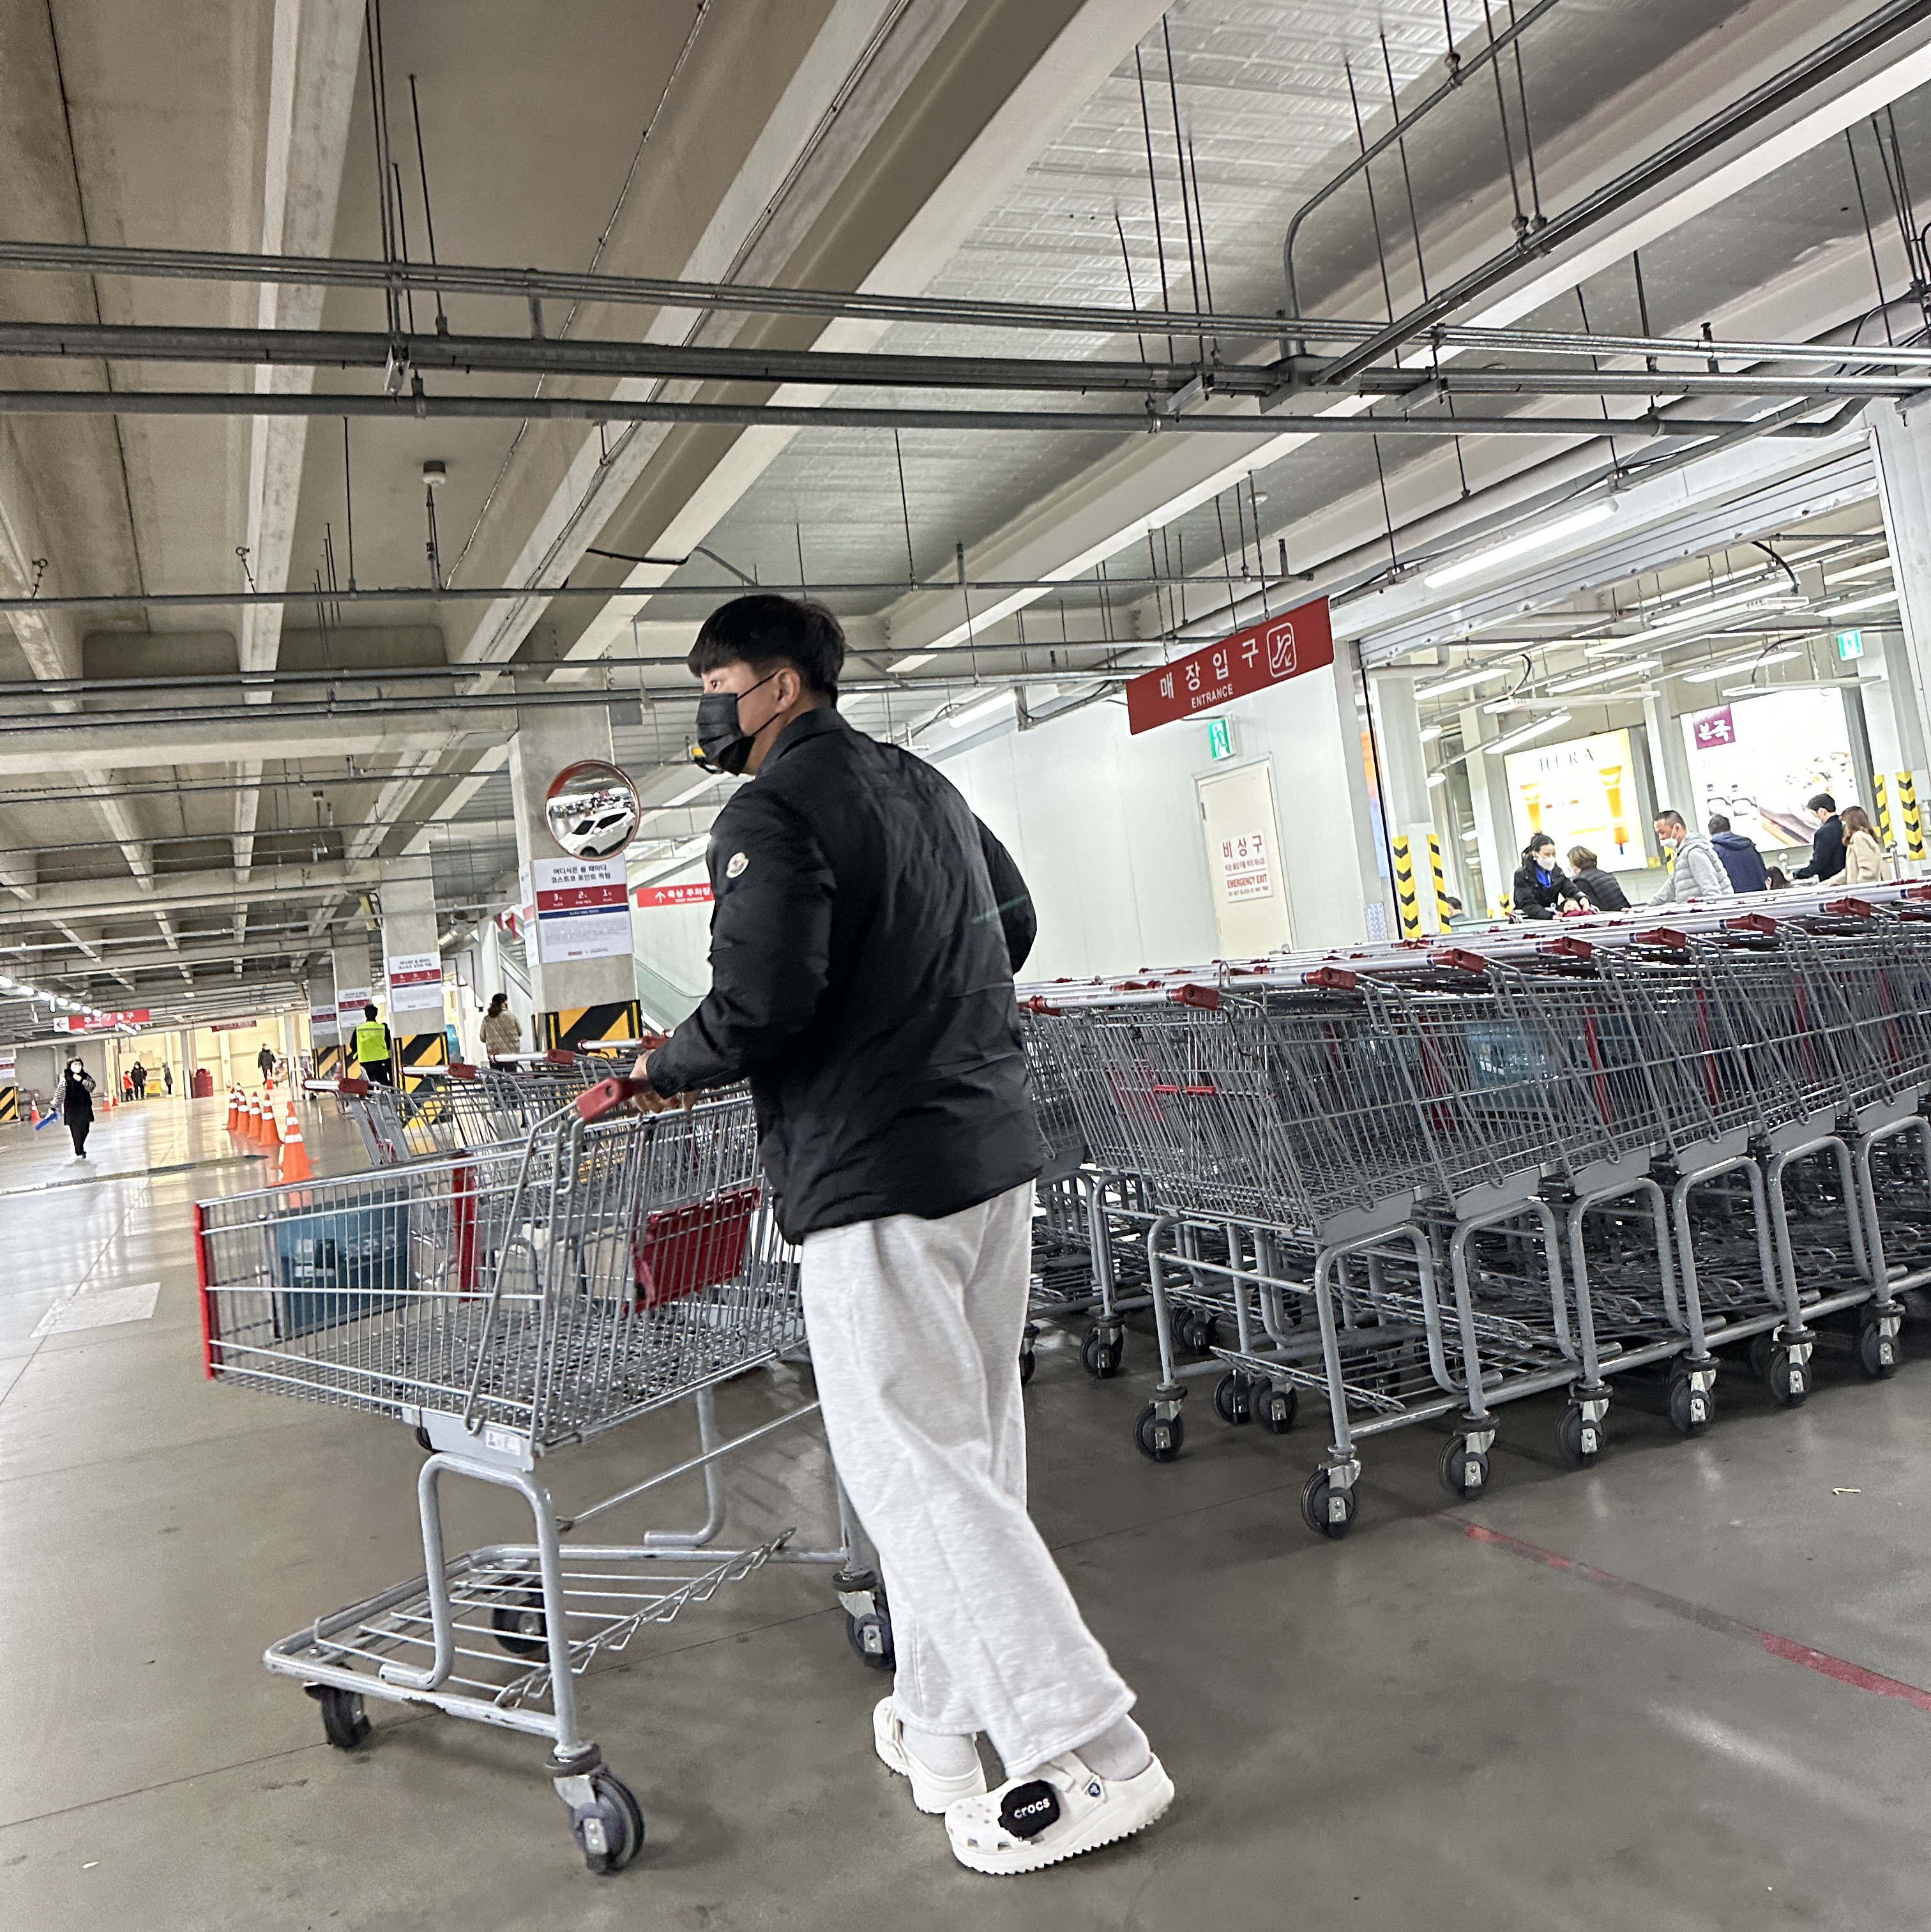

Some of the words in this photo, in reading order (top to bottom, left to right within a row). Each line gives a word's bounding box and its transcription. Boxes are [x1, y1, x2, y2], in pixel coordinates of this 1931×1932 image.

[1191, 683, 1234, 709] ENTRANCE
[1222, 835, 1262, 858] 비상구
[1227, 876, 1255, 888] EMERGENCY
[1256, 874, 1267, 884] EXIT
[1013, 1798, 1050, 1819] crocs
